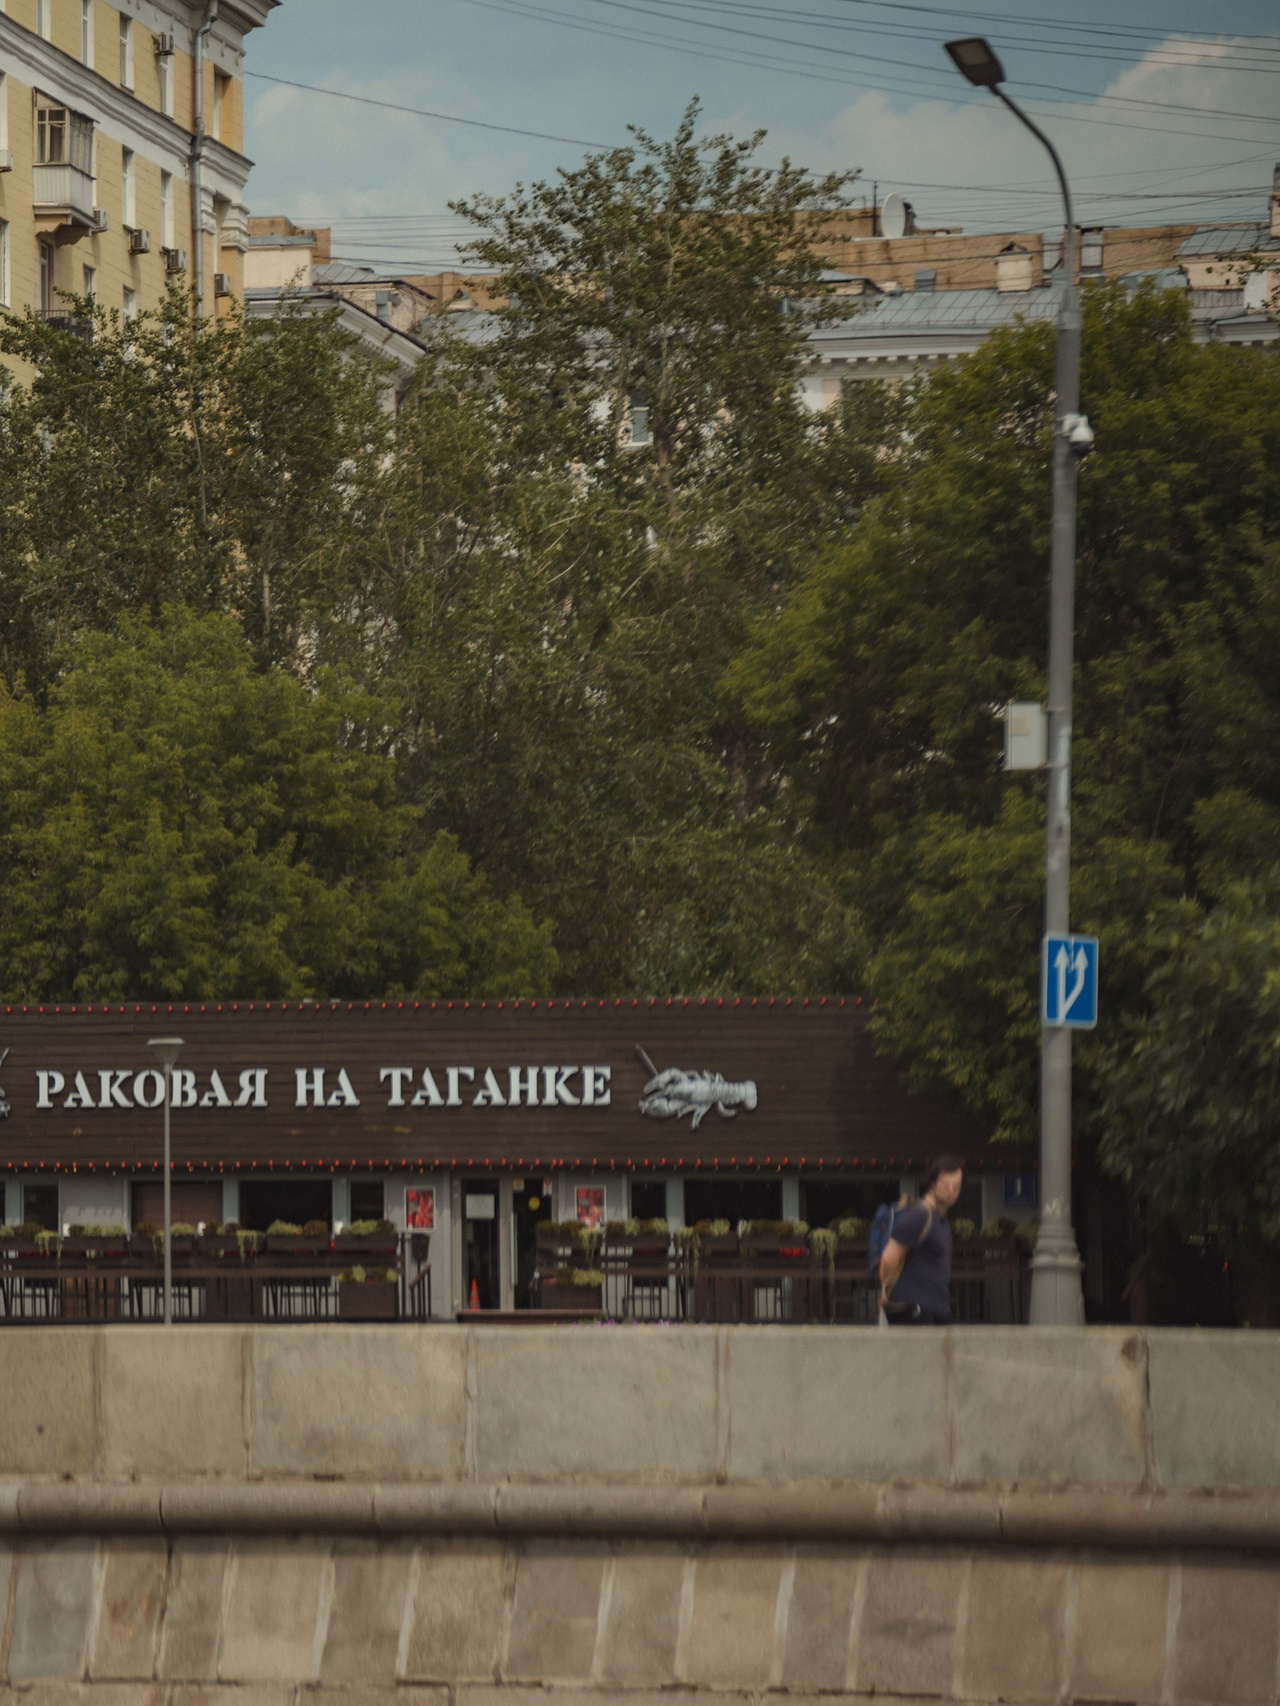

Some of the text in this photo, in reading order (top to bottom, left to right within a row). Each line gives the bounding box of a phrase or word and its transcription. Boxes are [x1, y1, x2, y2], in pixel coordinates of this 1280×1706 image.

[36, 1066, 611, 1107] РАКОВАЯ НА ТАГАНКЕ
